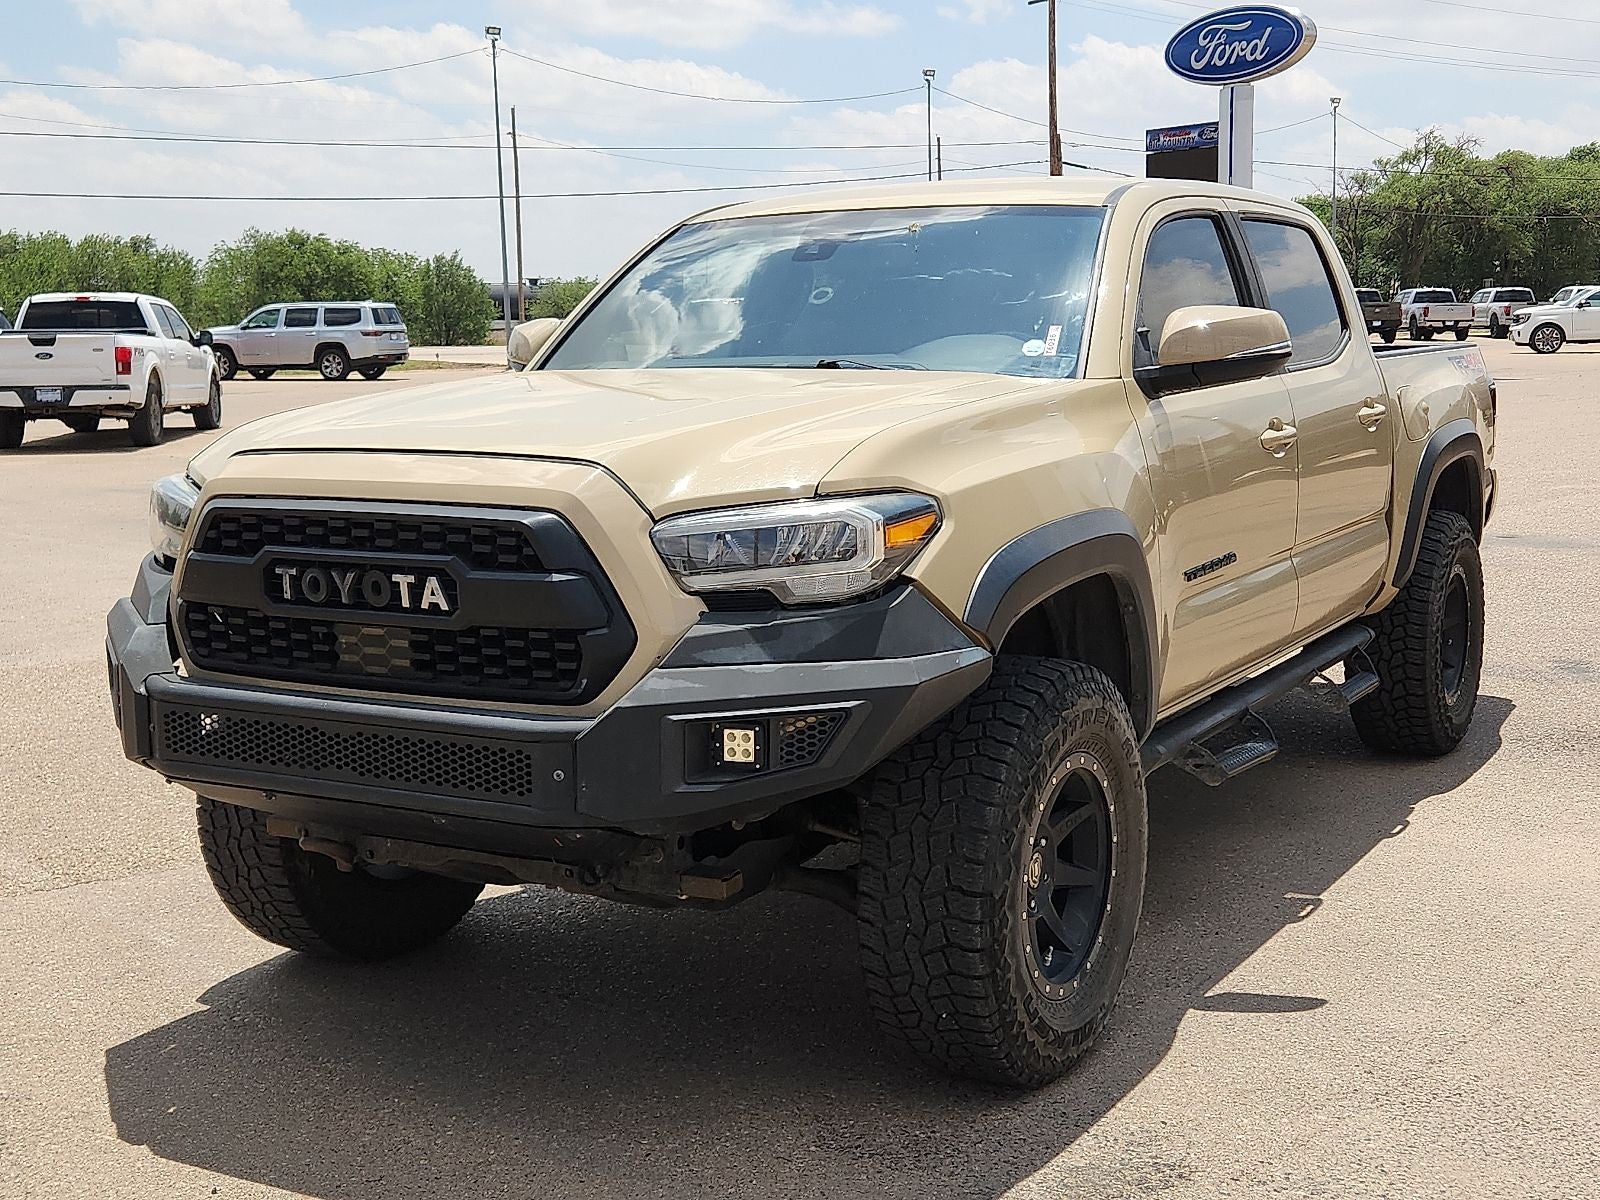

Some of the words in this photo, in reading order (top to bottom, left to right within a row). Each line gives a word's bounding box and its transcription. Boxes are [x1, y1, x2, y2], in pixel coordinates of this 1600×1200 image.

[1190, 20, 1273, 70] Ford
[1162, 136, 1197, 149] COUNTRY
[275, 567, 450, 611] TOYOTA
